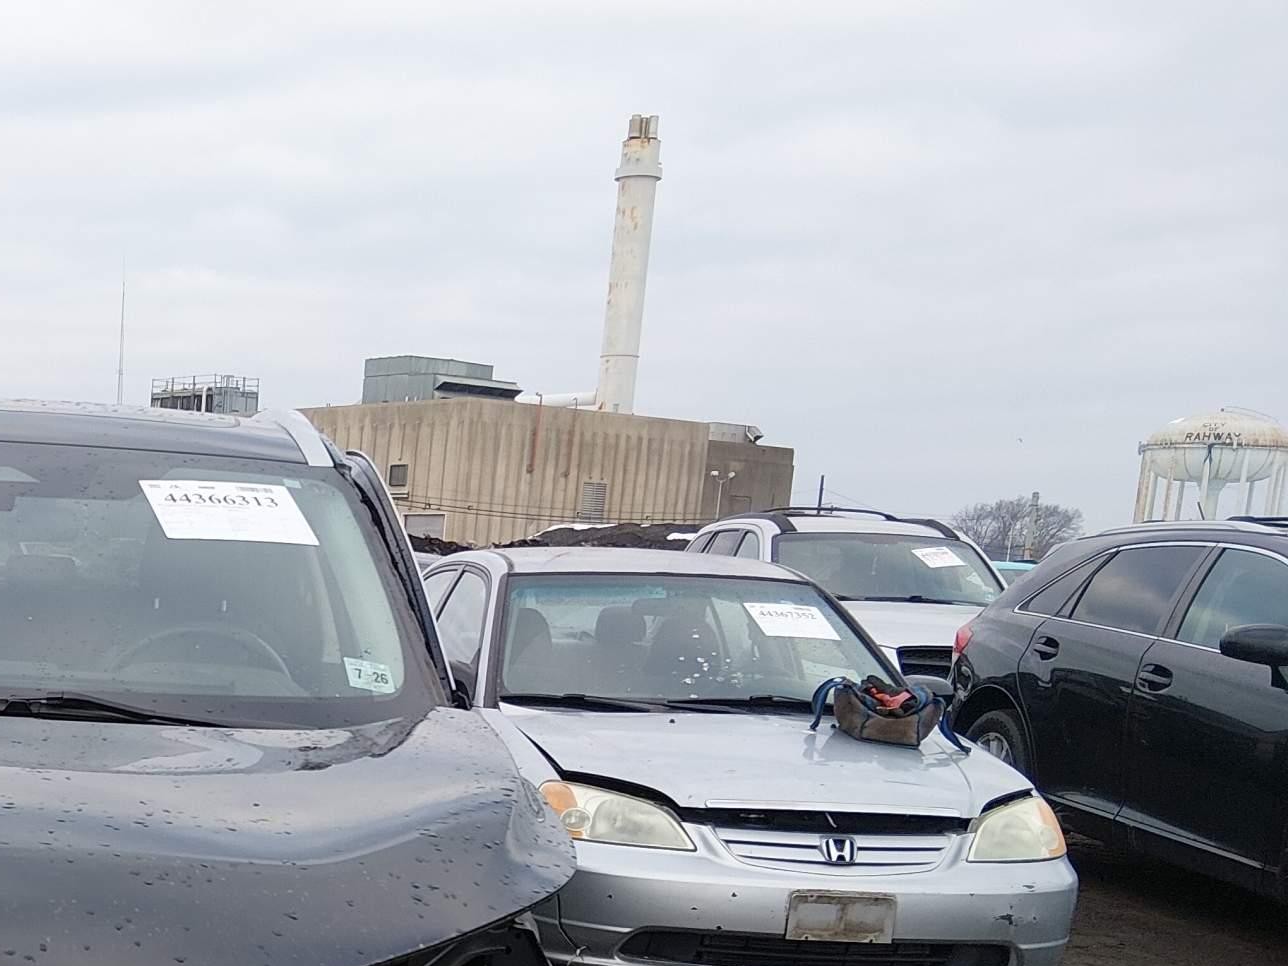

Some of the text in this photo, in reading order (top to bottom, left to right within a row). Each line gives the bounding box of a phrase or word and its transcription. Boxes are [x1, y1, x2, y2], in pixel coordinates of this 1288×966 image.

[1184, 432, 1242, 441] RAHWAY
[163, 492, 279, 508] 44366313
[758, 609, 817, 620] 44367352
